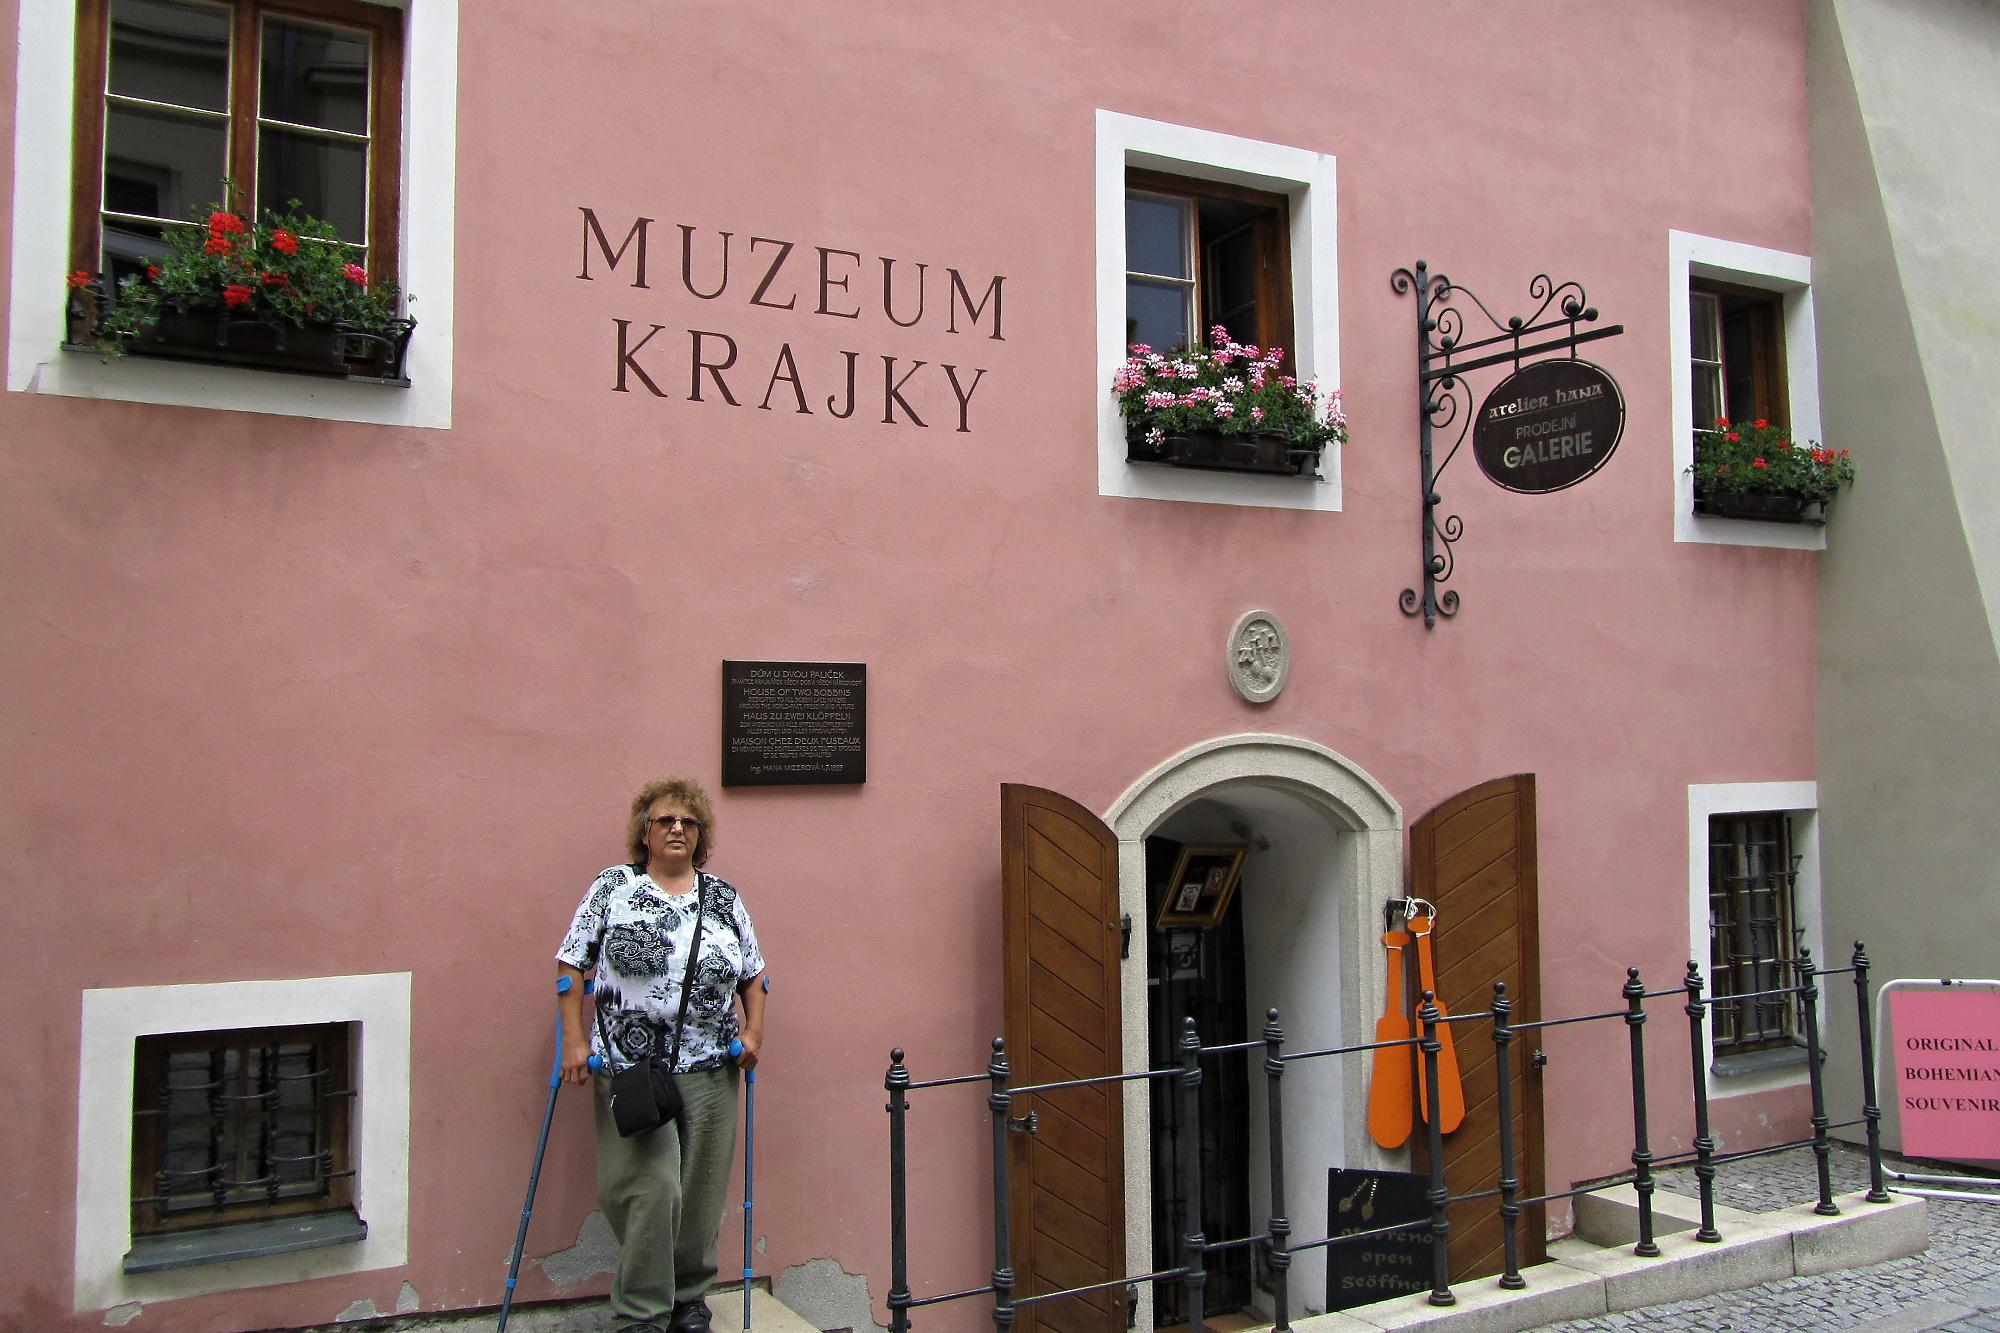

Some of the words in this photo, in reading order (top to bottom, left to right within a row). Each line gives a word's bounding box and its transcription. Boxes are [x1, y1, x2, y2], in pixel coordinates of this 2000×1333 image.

[576, 206, 1007, 341] MUZEUM
[611, 318, 988, 433] KRAJKY
[1503, 431, 1592, 468] GALERIE
[807, 712, 850, 720] KLÖPPELN
[1907, 1038, 1998, 1052] ORIGINAL
[1361, 1251, 1413, 1266] open
